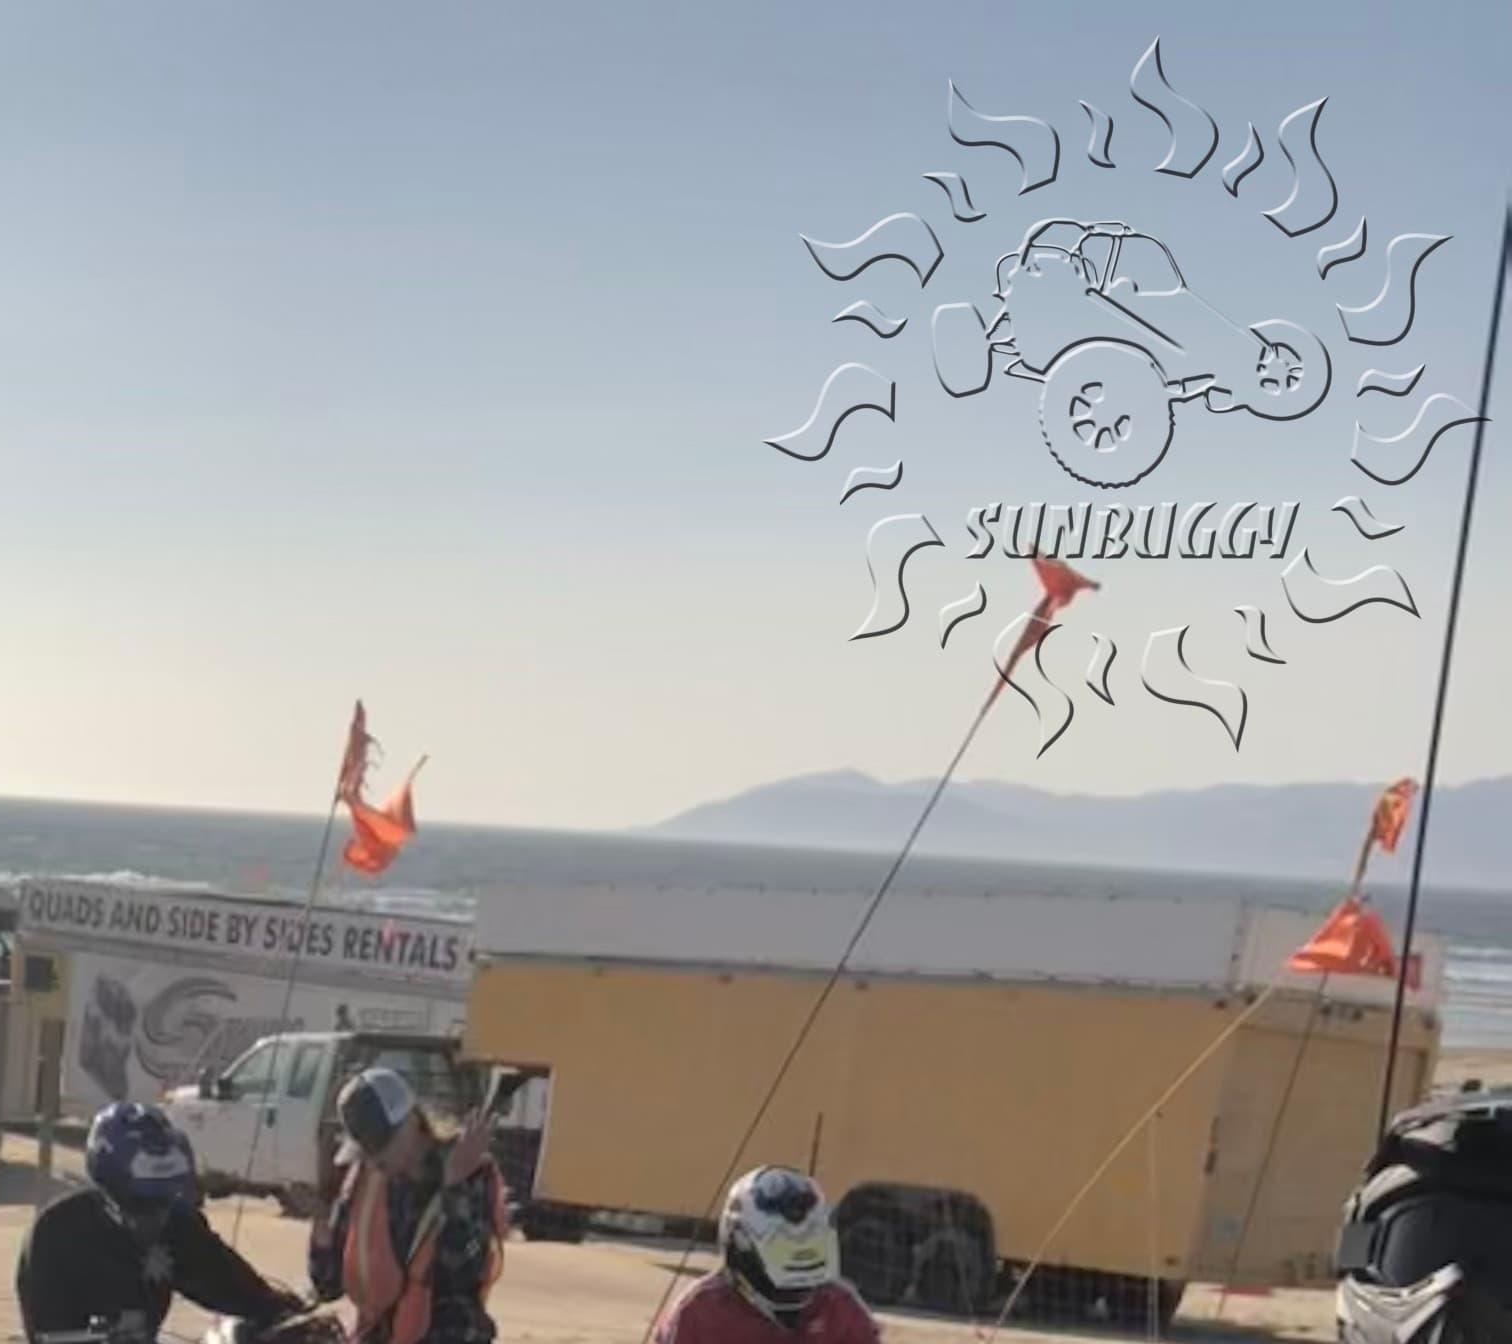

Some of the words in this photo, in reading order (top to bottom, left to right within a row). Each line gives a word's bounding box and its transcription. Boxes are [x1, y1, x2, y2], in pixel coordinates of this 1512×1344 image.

[29, 891, 104, 928] QUADS
[109, 901, 160, 934] AND
[166, 905, 219, 942] SIDE
[226, 913, 258, 946] BY
[343, 925, 459, 971] RENTALS
